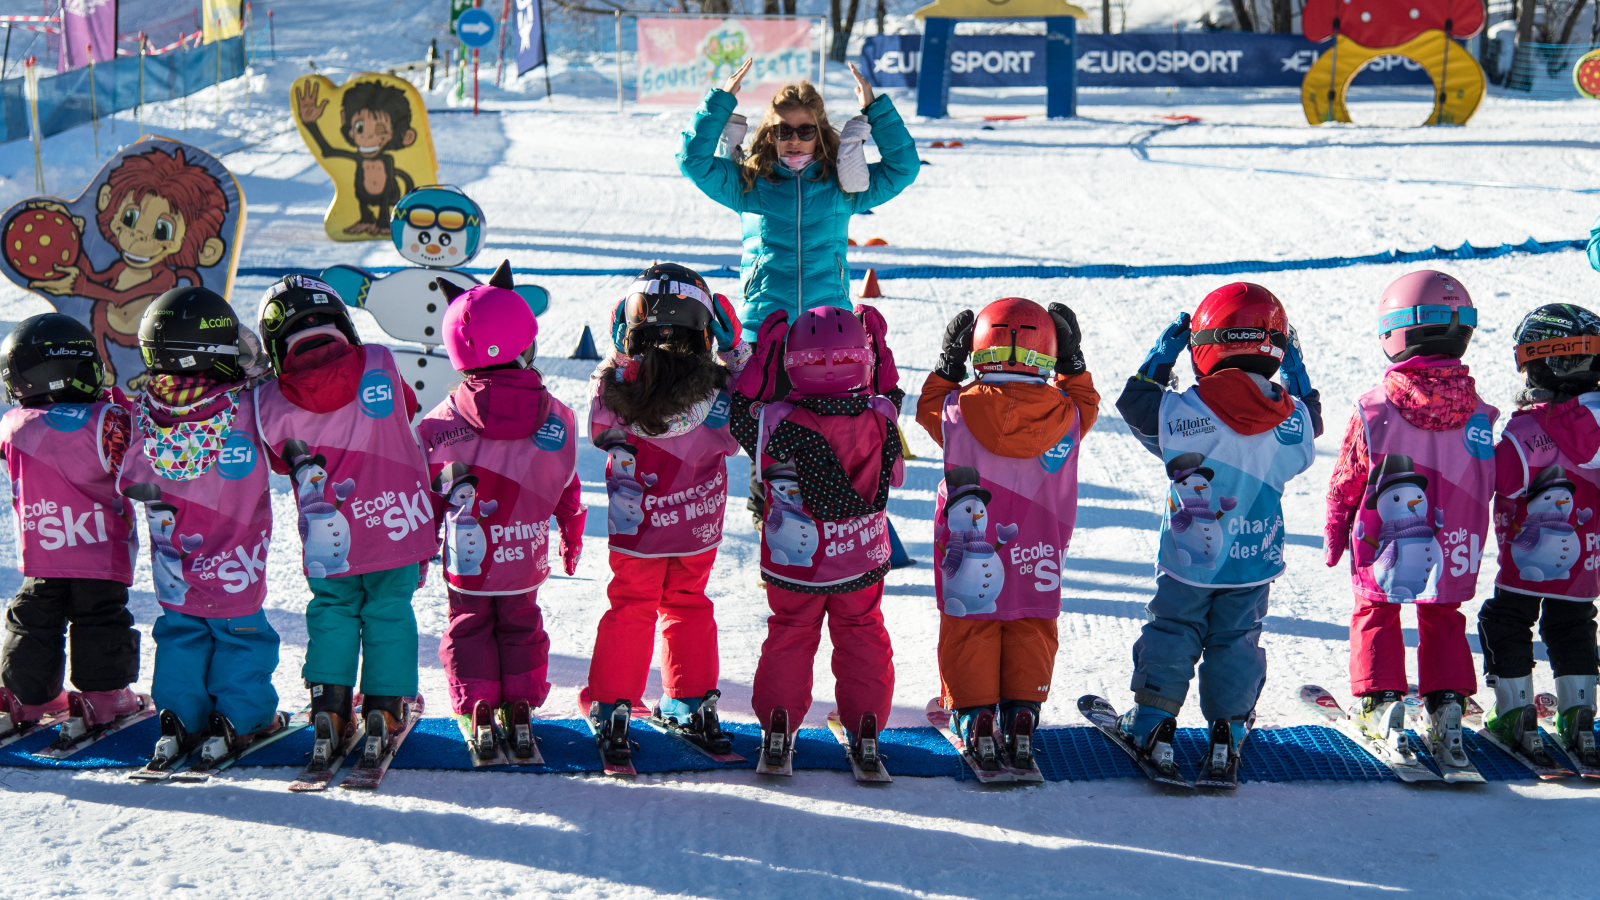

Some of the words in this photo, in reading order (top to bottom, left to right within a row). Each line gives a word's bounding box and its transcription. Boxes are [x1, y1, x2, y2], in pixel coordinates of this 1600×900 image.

[746, 52, 806, 81] ERTE
[1077, 50, 1243, 73] EUROSPORT
[1227, 331, 1266, 340] loubsol
[1167, 416, 1211, 436] Valloire
[428, 425, 471, 450] Valloire
[1467, 426, 1494, 447] ES
[1523, 434, 1552, 453] Vallo
[22, 499, 58, 518] cole
[351, 491, 396, 520] École
[365, 515, 381, 528] de
[651, 510, 679, 527] des
[493, 546, 525, 563] des
[825, 539, 855, 557] des
[1010, 542, 1055, 565] École
[1229, 542, 1258, 559] des
[1019, 563, 1033, 575] de
[1584, 554, 1600, 571] de
[199, 571, 216, 581] de
